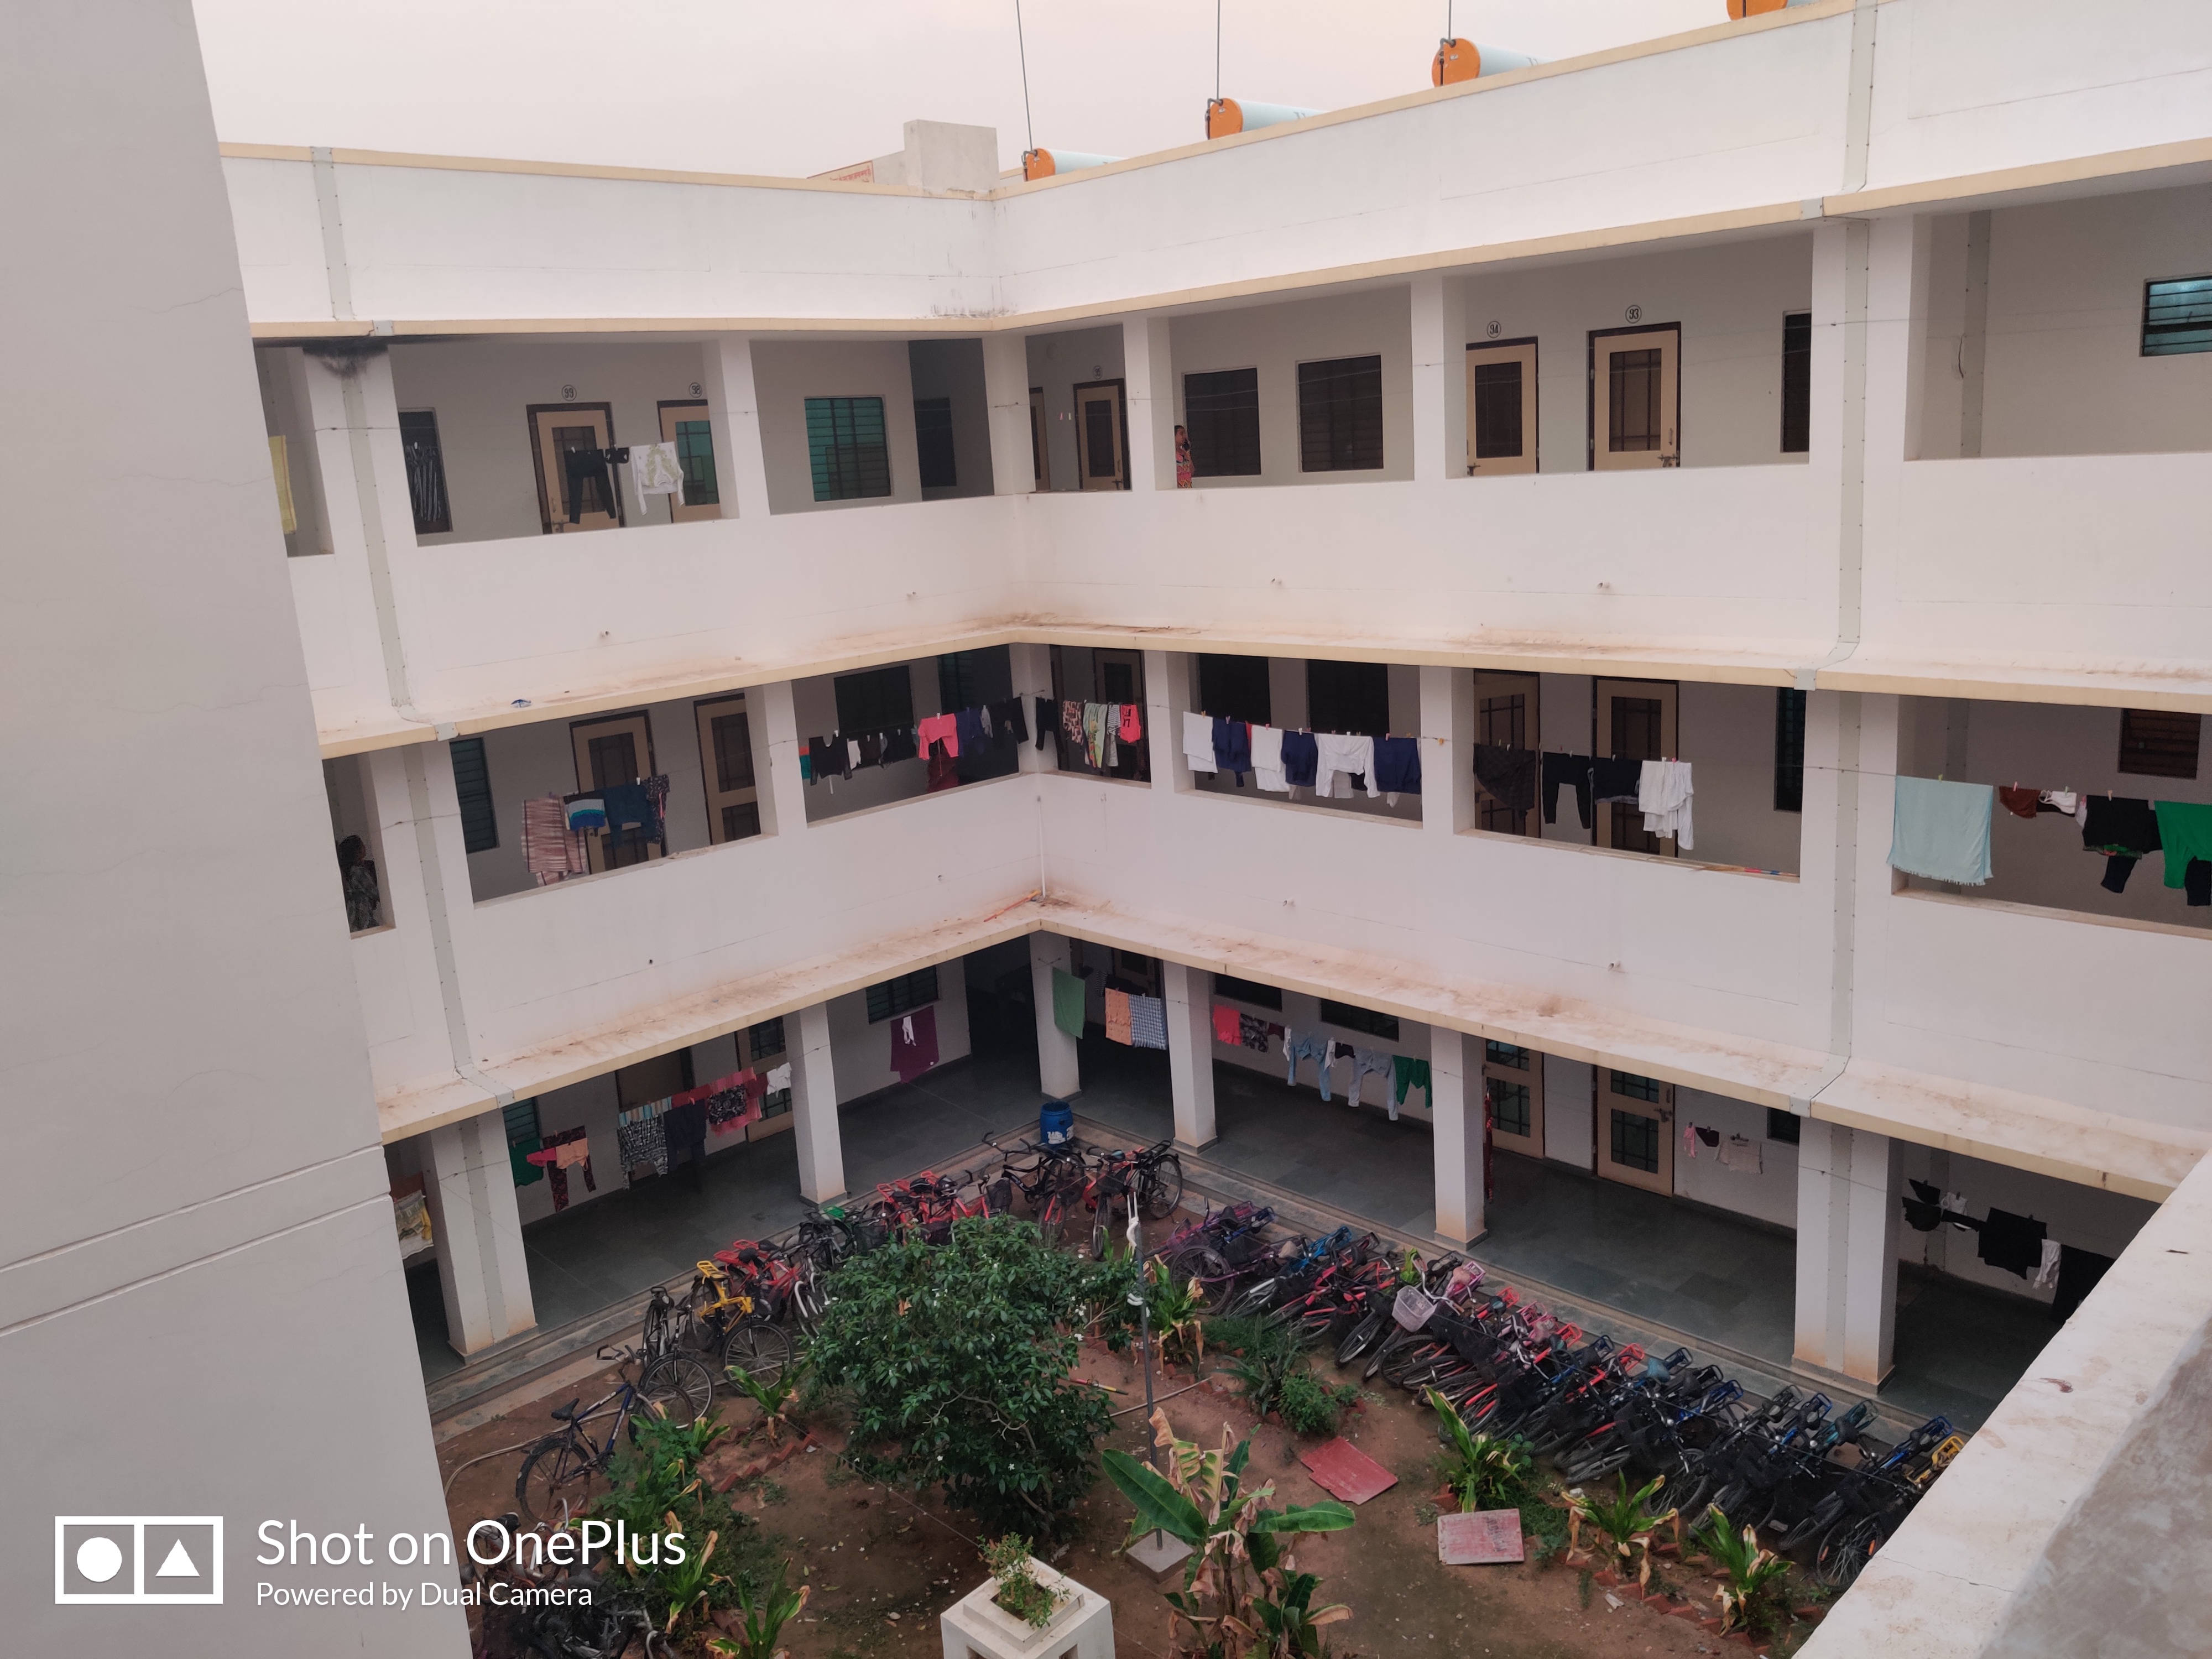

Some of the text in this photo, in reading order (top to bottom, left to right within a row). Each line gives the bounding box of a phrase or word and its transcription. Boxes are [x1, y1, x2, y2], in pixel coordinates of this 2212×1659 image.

[1629, 309, 1639, 320] 93
[1489, 324, 1499, 335] 94
[564, 388, 574, 398] 99
[692, 385, 701, 395] 98
